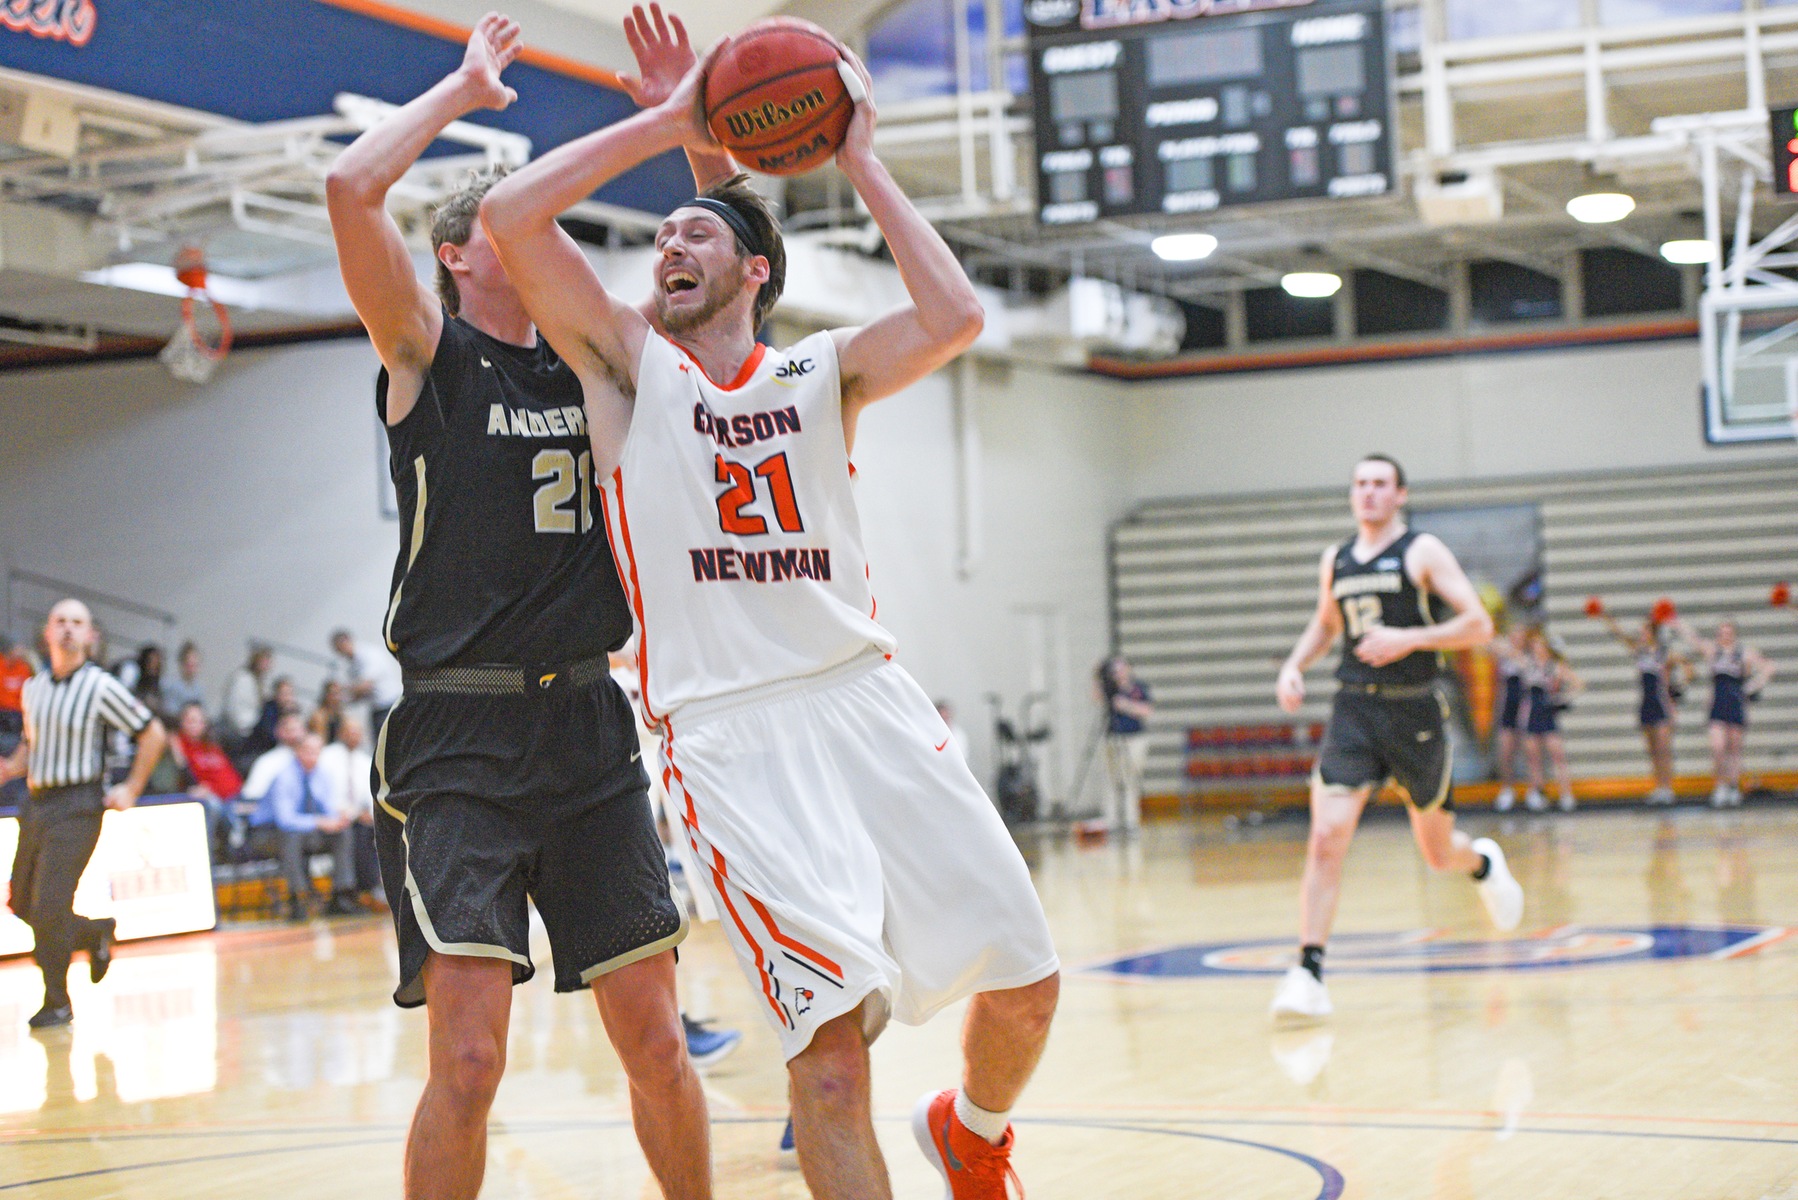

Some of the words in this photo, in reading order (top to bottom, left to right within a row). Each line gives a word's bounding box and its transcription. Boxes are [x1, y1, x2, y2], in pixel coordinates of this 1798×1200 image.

[726, 87, 827, 139] Wilson
[776, 358, 816, 377] SAC
[487, 403, 588, 438] ANDER
[714, 452, 804, 535] 21
[689, 549, 831, 582] NEWMAN
